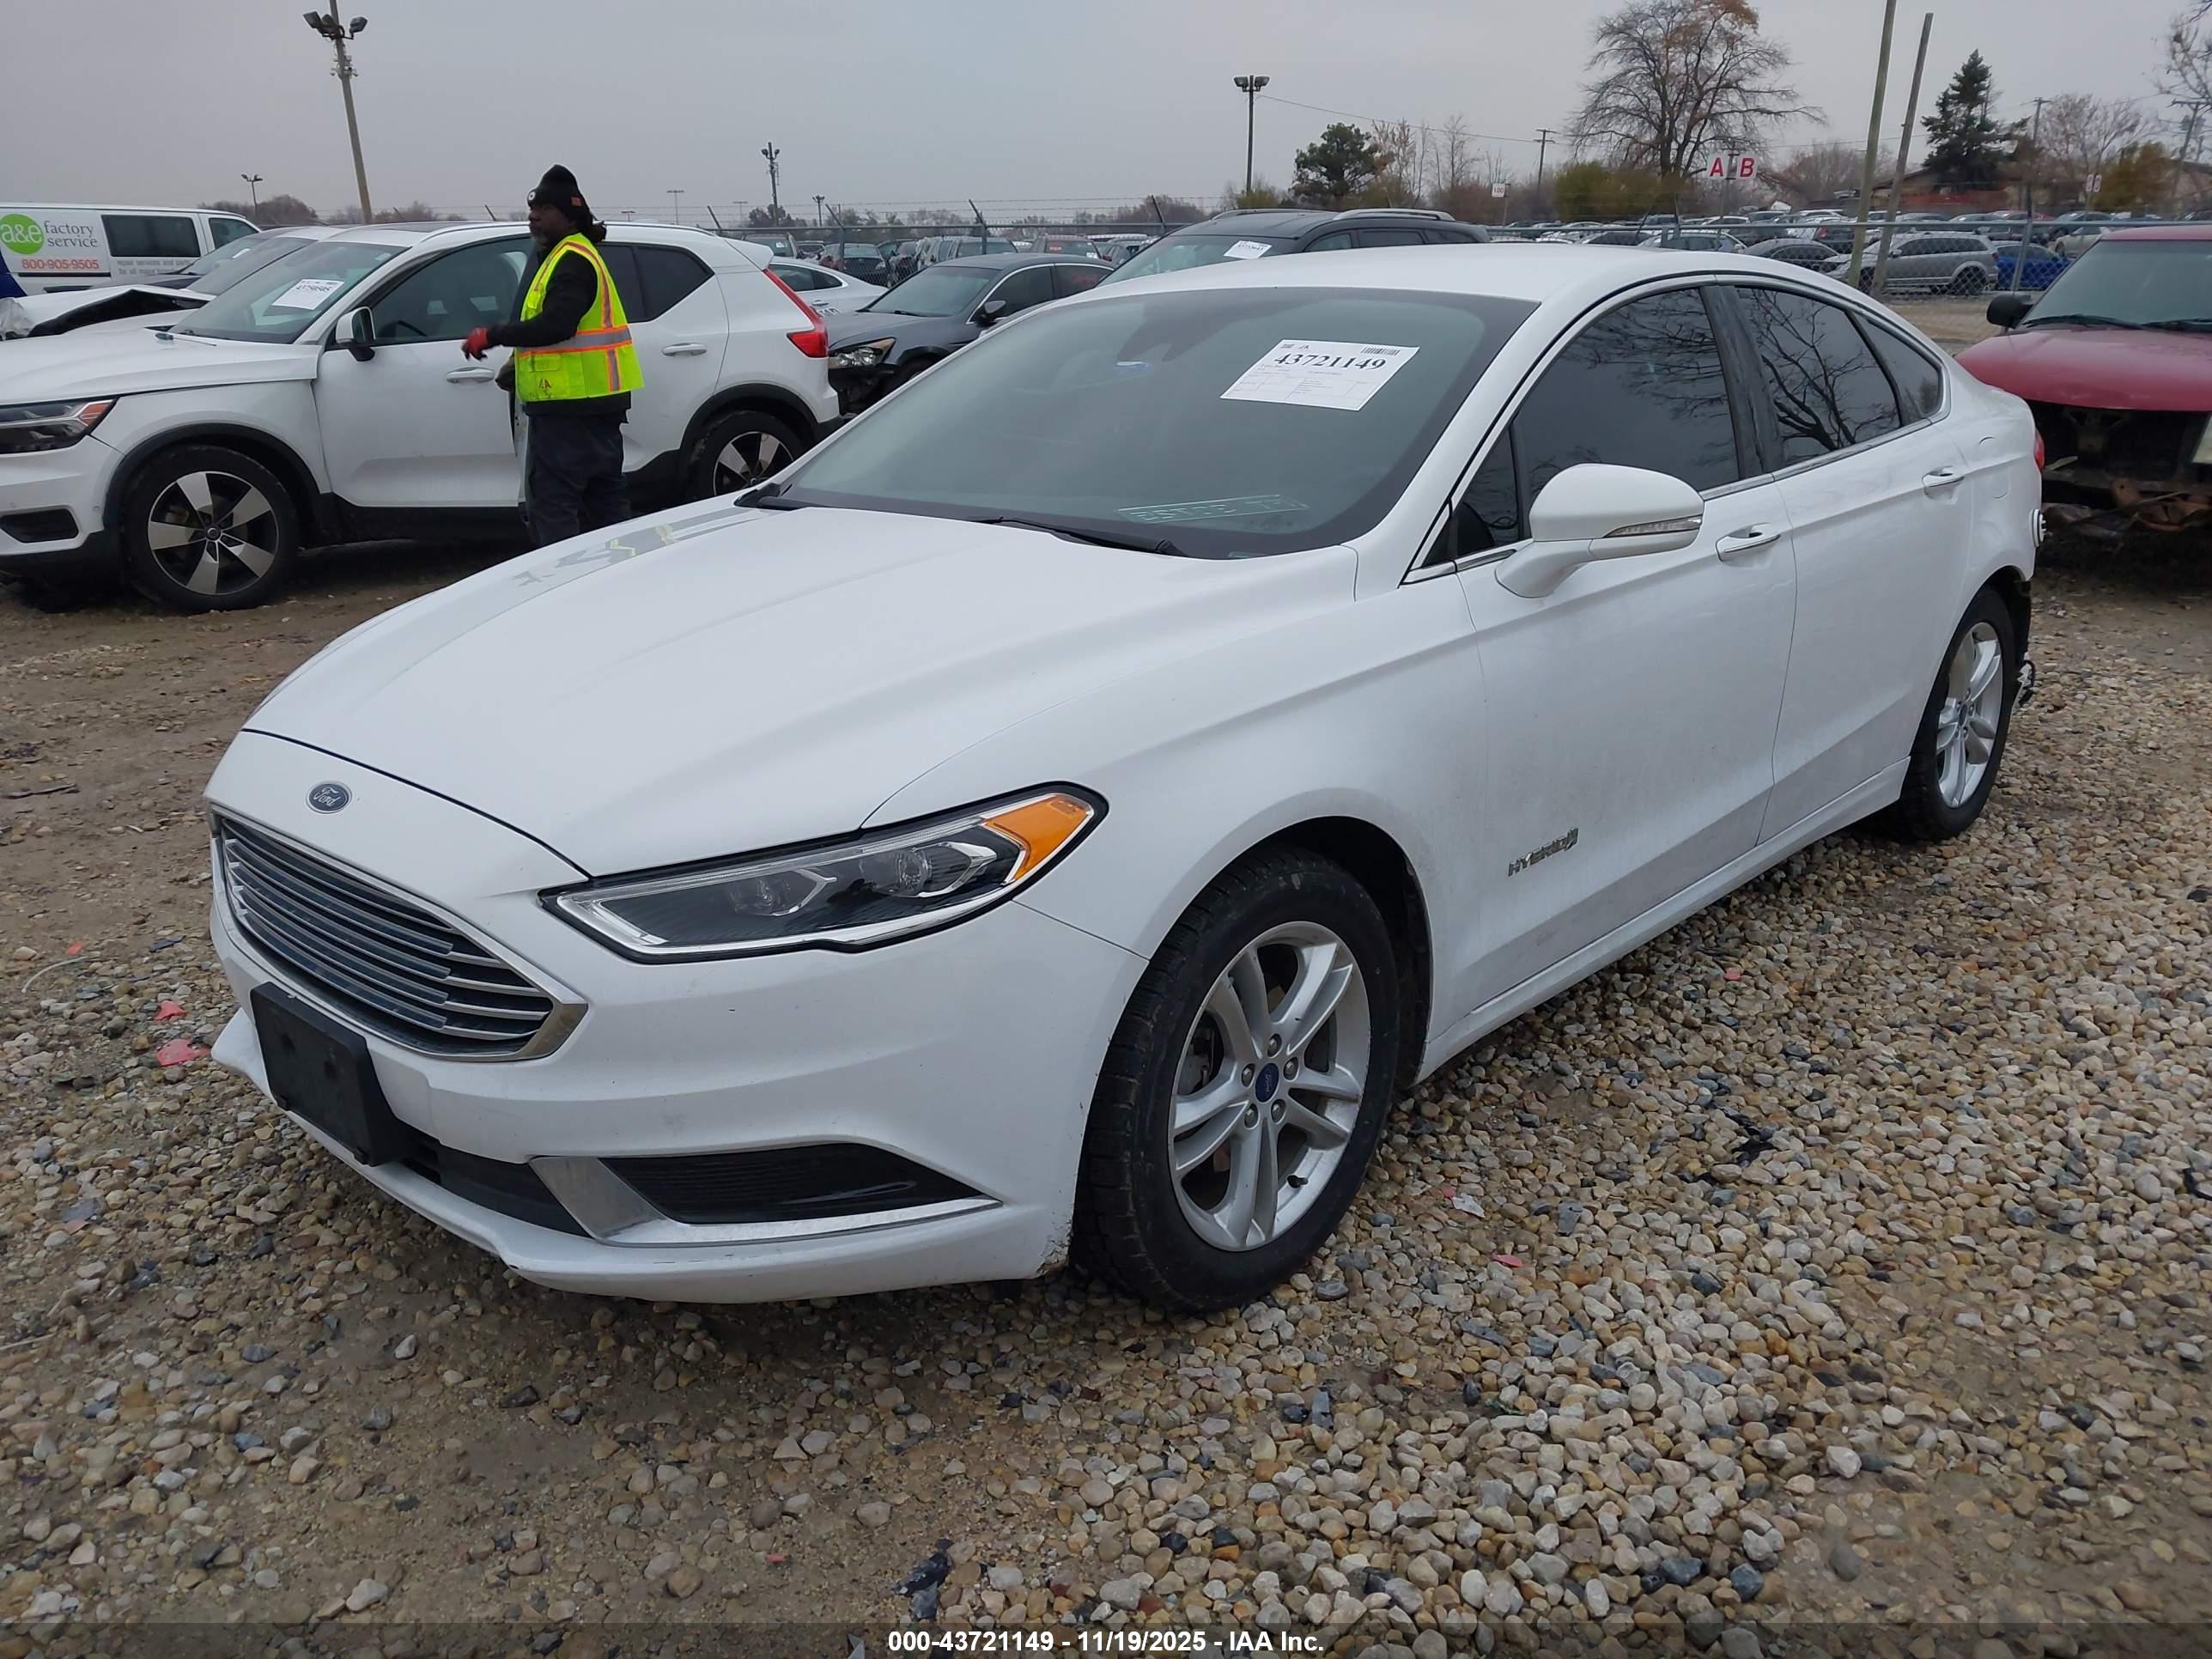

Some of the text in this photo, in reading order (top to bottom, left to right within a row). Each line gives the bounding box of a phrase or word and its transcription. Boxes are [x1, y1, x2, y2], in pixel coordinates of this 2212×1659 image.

[1710, 157, 1724, 178] A
[1740, 157, 1755, 178] B
[0, 223, 42, 244] a&e
[44, 220, 94, 239] factory
[48, 234, 99, 247] service
[21, 259, 100, 270] 800-905-9505
[1274, 352, 1387, 370] 43721149
[313, 787, 341, 807] Ford
